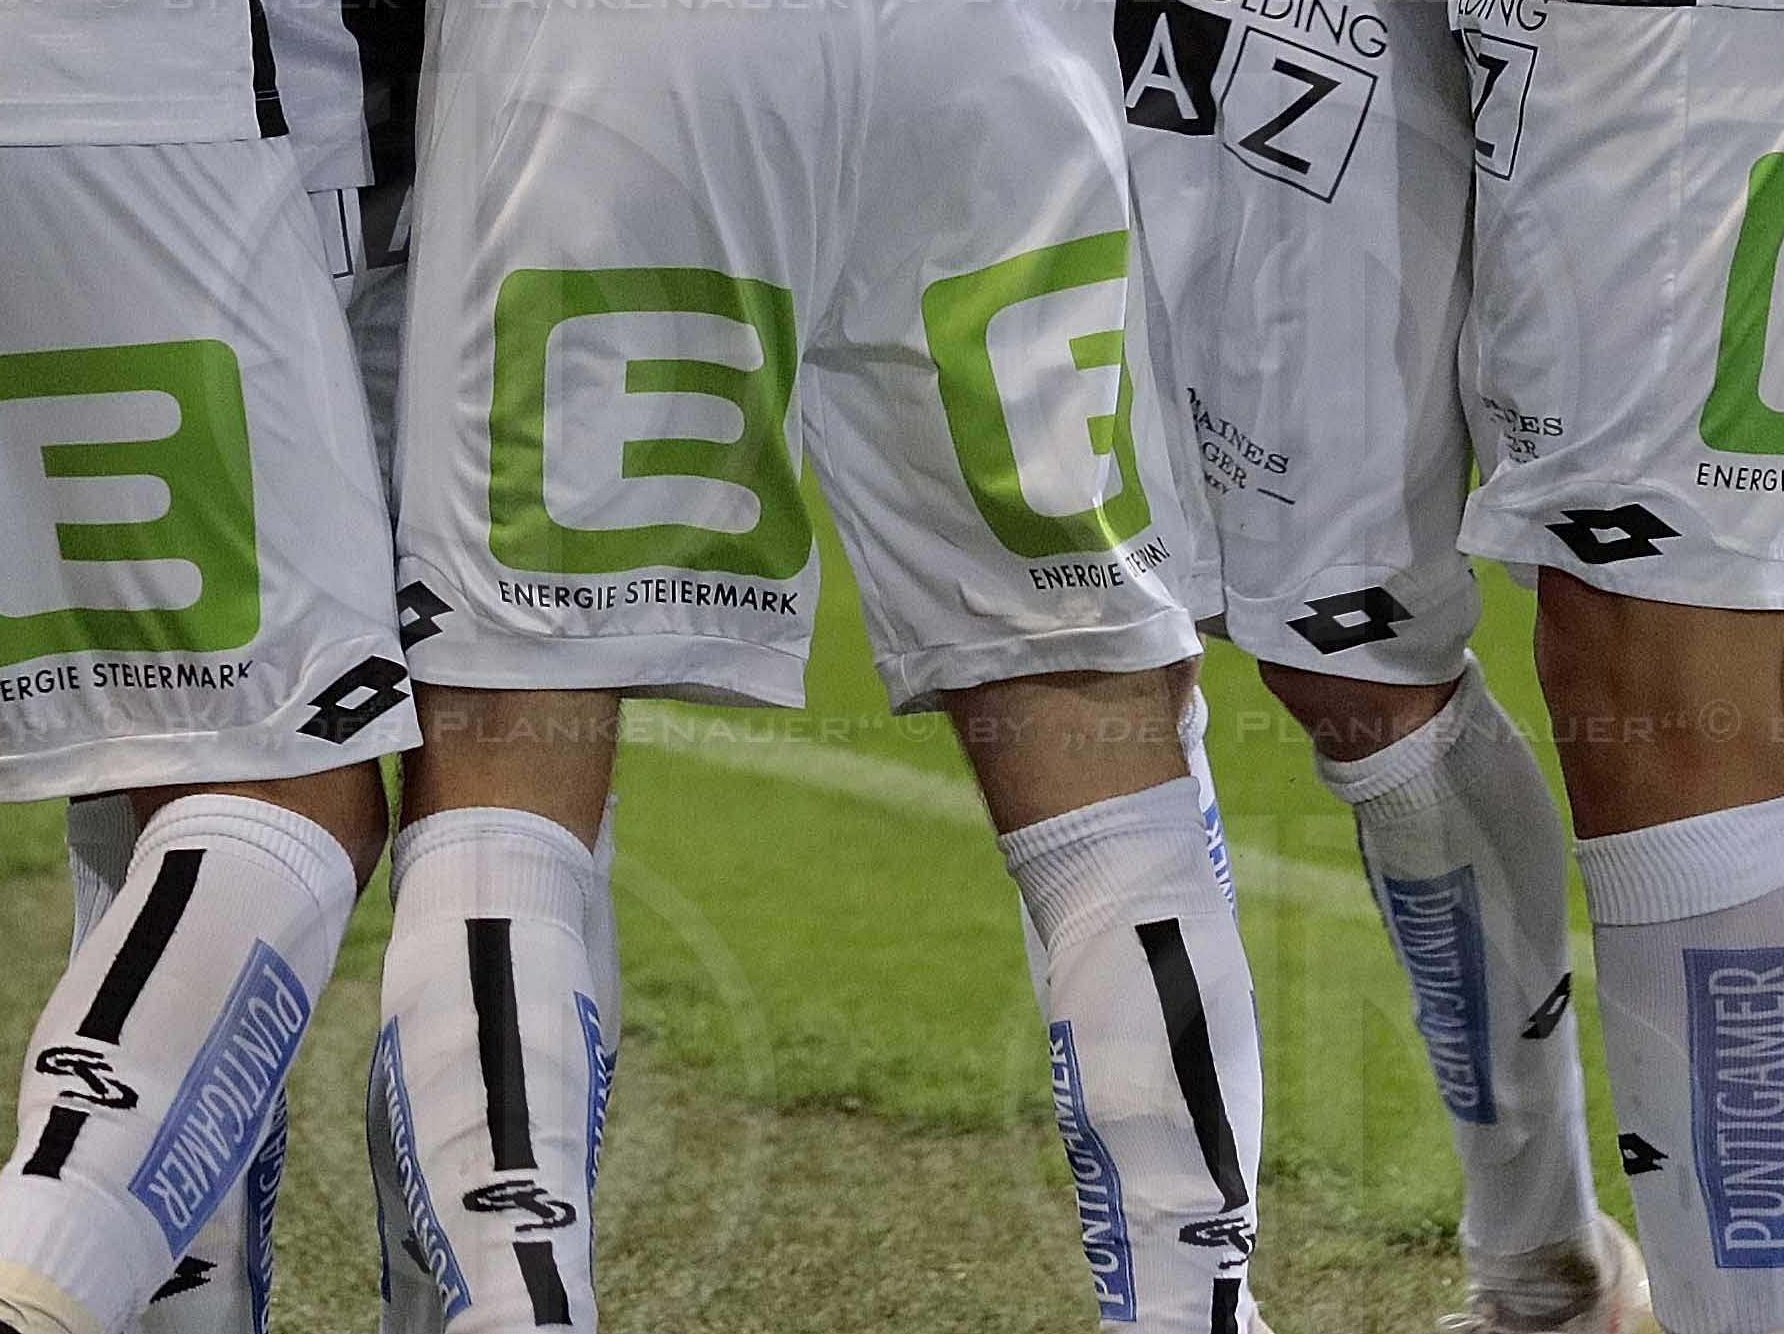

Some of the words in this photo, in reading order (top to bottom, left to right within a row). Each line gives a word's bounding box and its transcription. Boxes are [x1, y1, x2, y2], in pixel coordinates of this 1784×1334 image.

[1031, 562, 1124, 590] ENERGIE
[498, 579, 616, 610] ENERGIE
[624, 577, 800, 616] STEIERMARK
[92, 660, 253, 690] STEIERMARK
[1394, 883, 1481, 1113] PUNTIGAMER
[148, 961, 304, 1235] PUNTIGAMER
